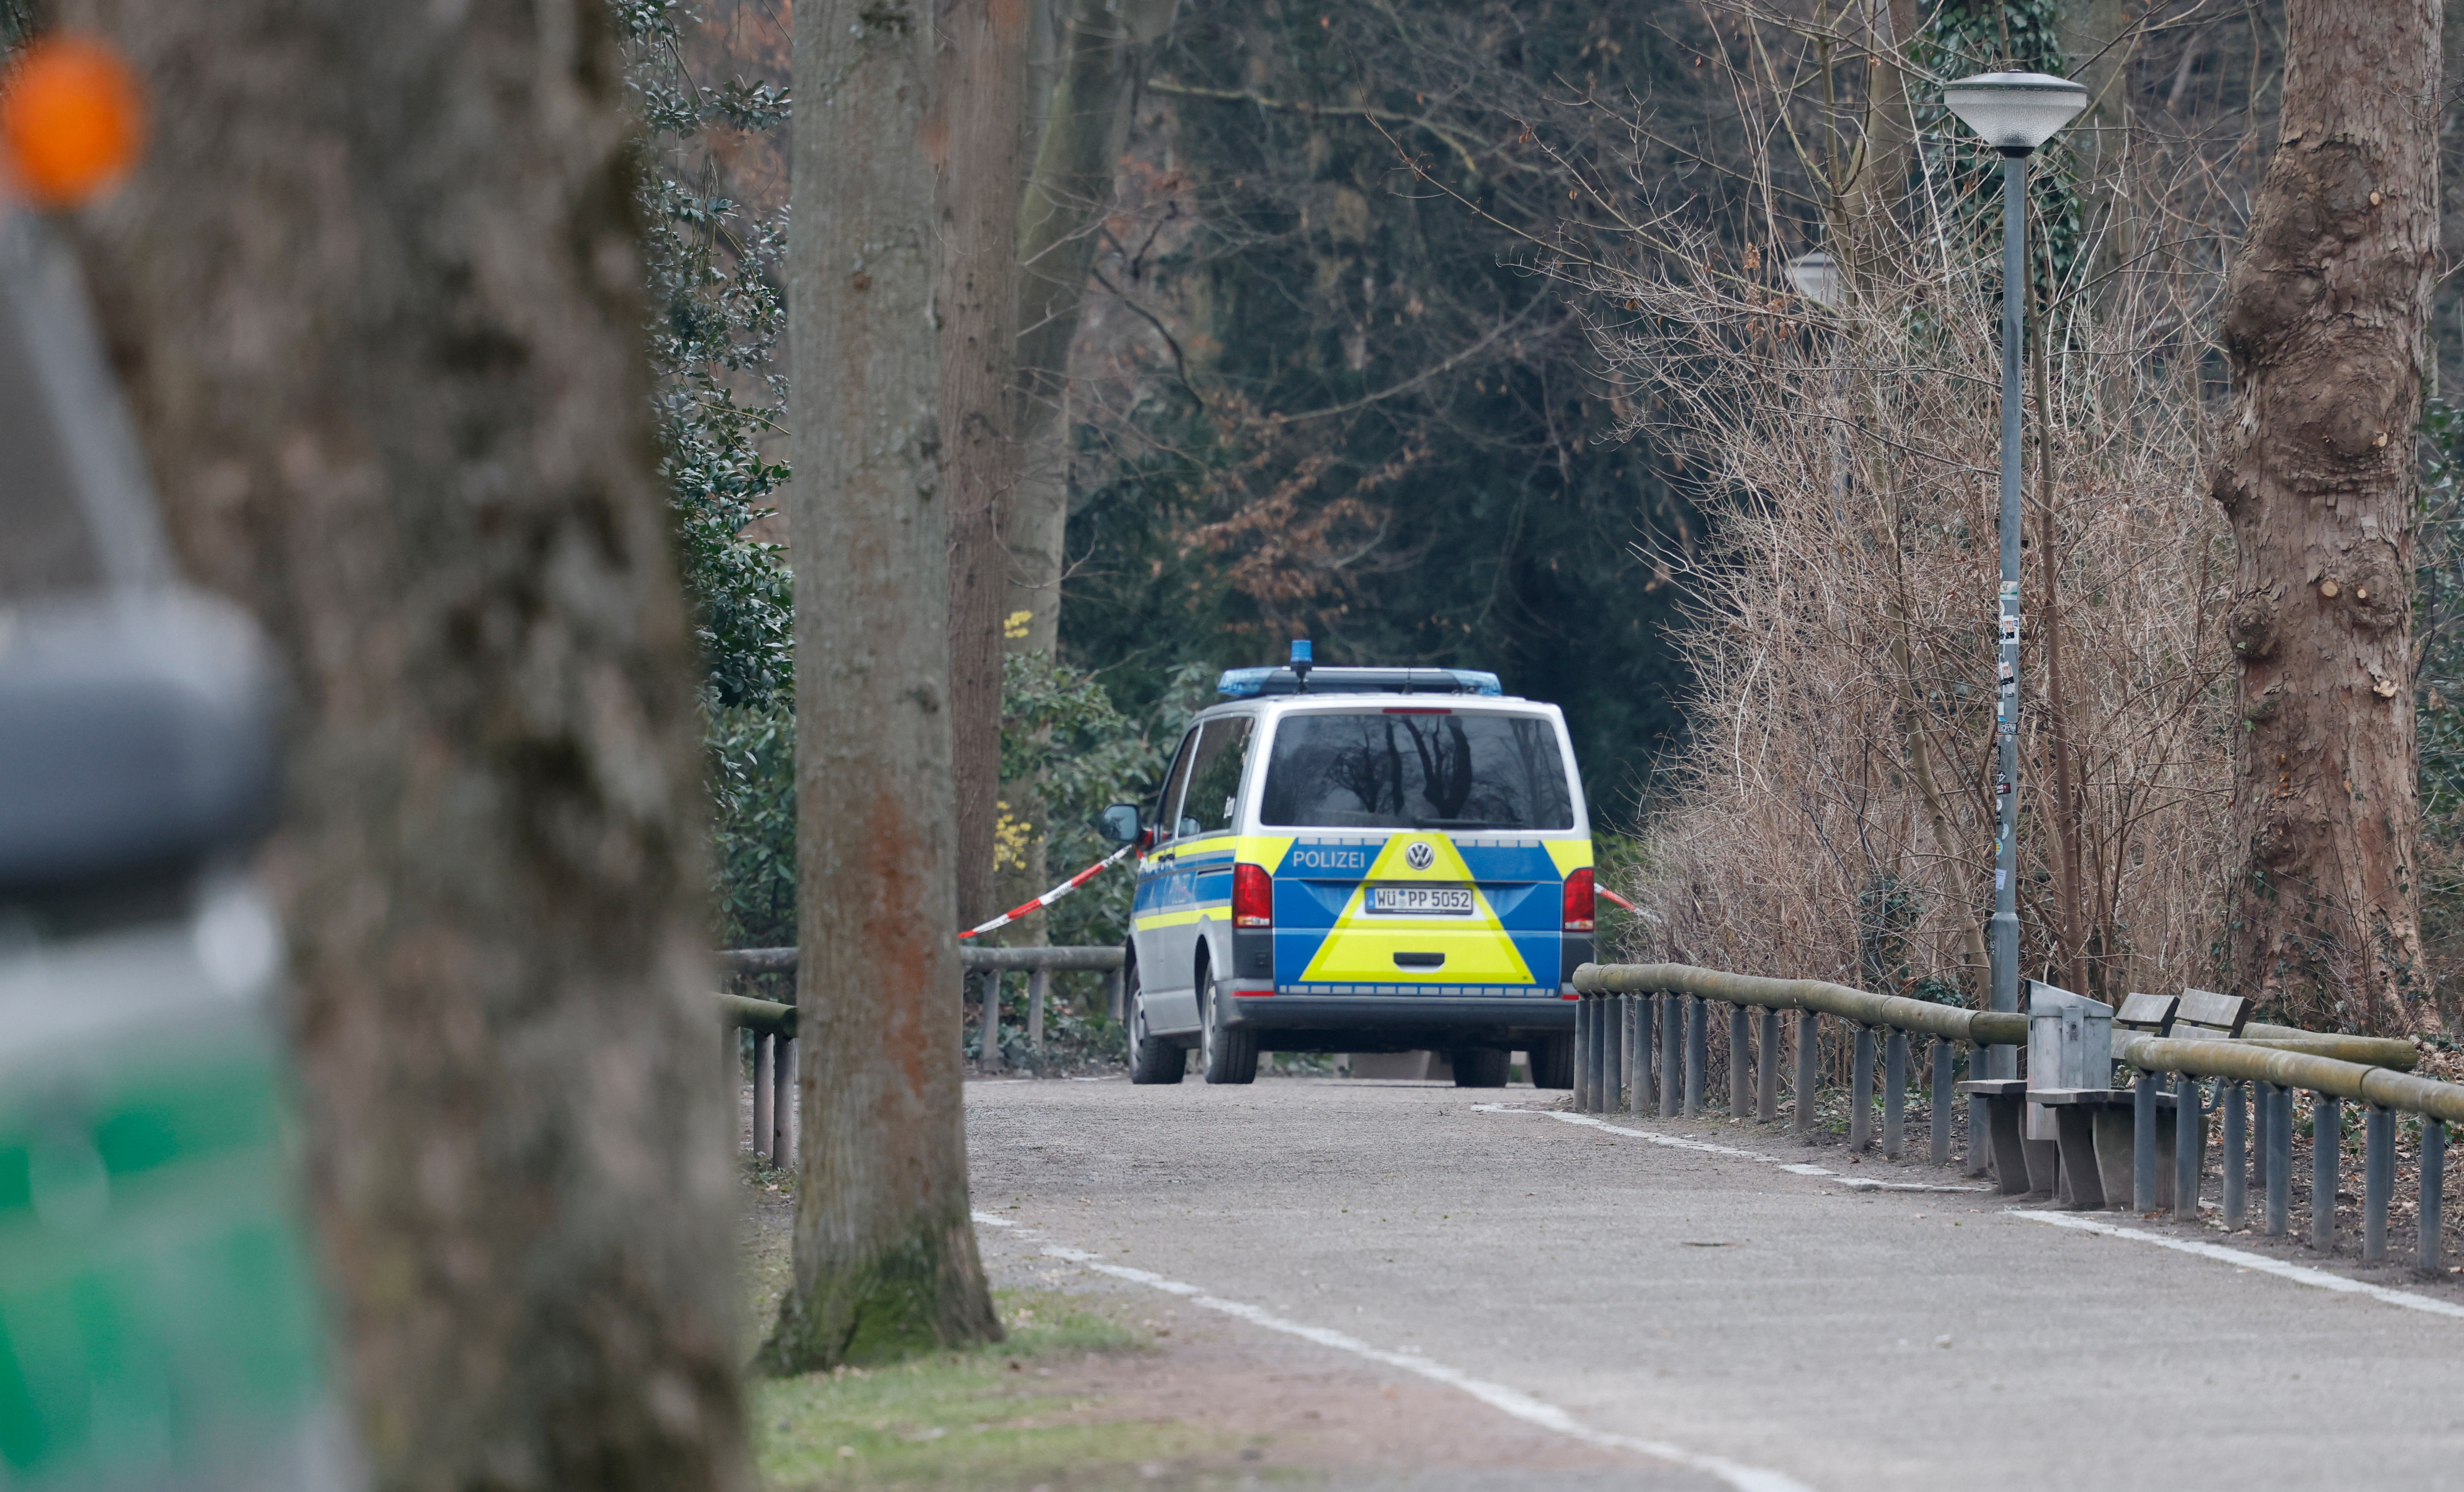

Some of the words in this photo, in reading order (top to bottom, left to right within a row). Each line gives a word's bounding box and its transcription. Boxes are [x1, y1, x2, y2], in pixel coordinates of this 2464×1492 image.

[1293, 851, 1365, 868] POLIZEI
[1378, 890, 1395, 906] WÜ
[1408, 891, 1427, 906] PP
[1432, 892, 1469, 907] 5052
